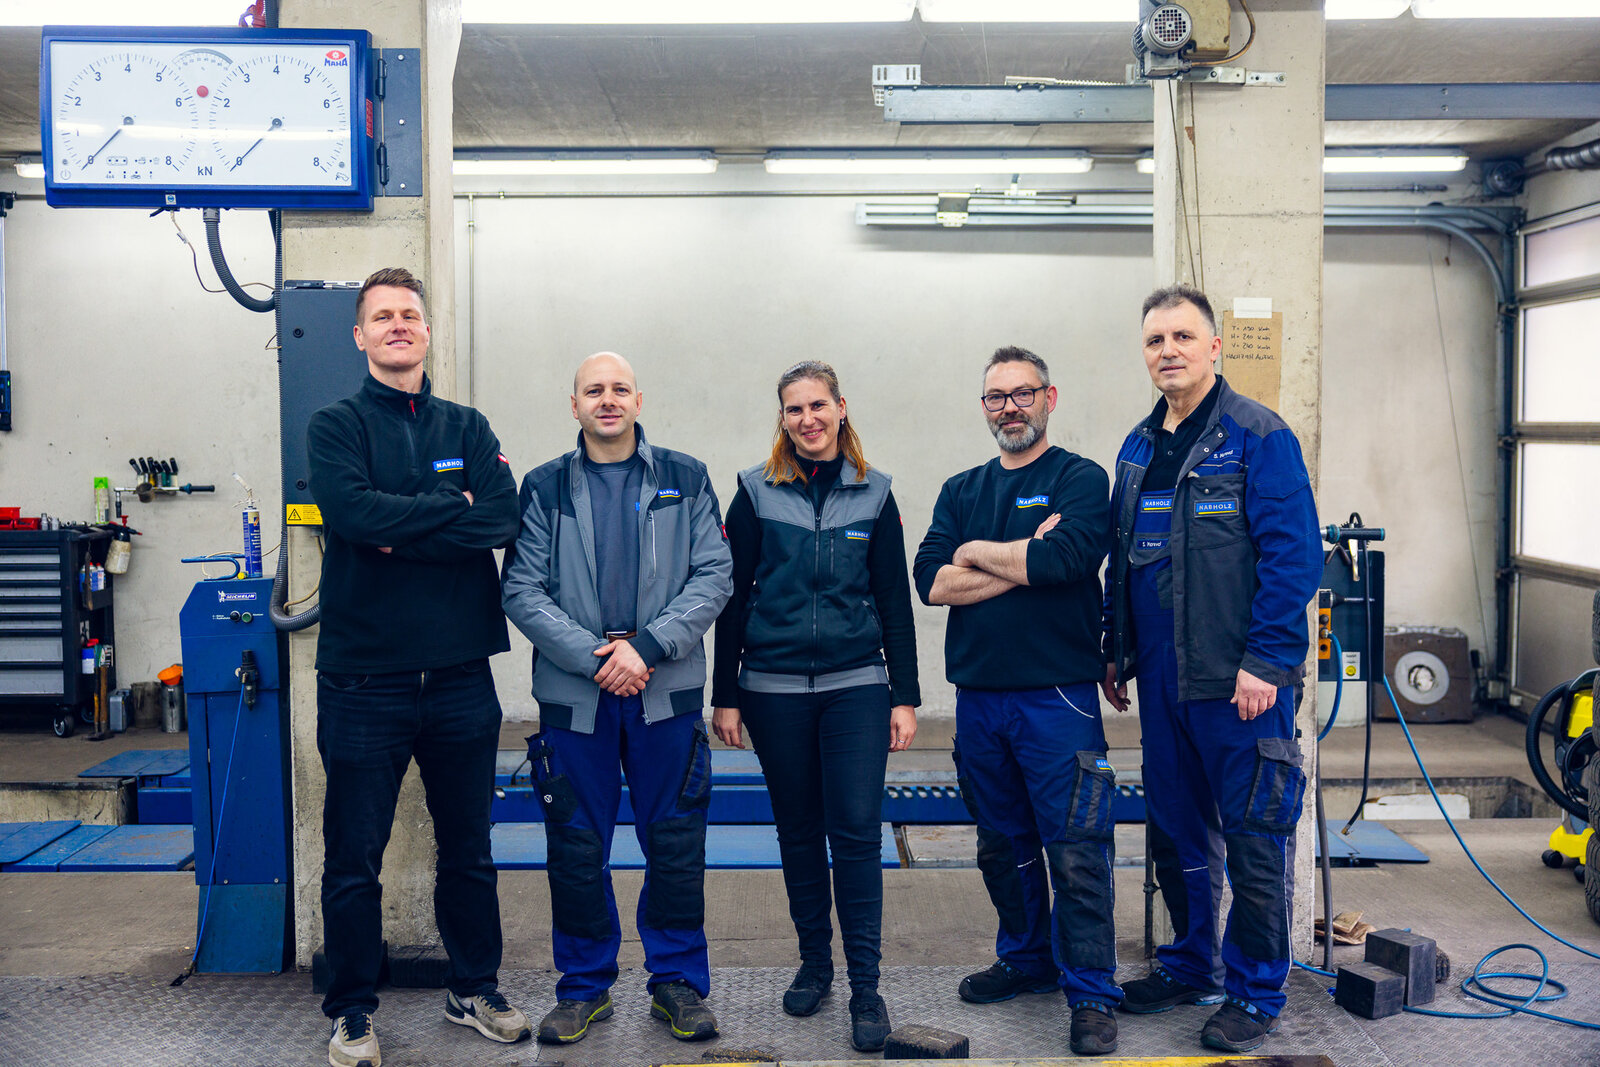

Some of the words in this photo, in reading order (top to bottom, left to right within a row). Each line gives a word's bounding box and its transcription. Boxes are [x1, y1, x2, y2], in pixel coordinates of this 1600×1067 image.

[324, 58, 347, 66] MAHA
[125, 64, 131, 72] 4
[273, 66, 280, 74] 4
[95, 72, 101, 81] 3
[156, 73, 162, 82] 5
[244, 74, 250, 83] 3
[304, 74, 310, 83] 5
[75, 97, 81, 106] 2
[176, 98, 182, 107] 6
[224, 98, 230, 108] 2
[324, 99, 330, 108] 6
[88, 155, 94, 164] 0
[166, 156, 172, 165] 8
[236, 157, 242, 166] 0
[314, 157, 319, 166] 8
[197, 166, 212, 176] kN
